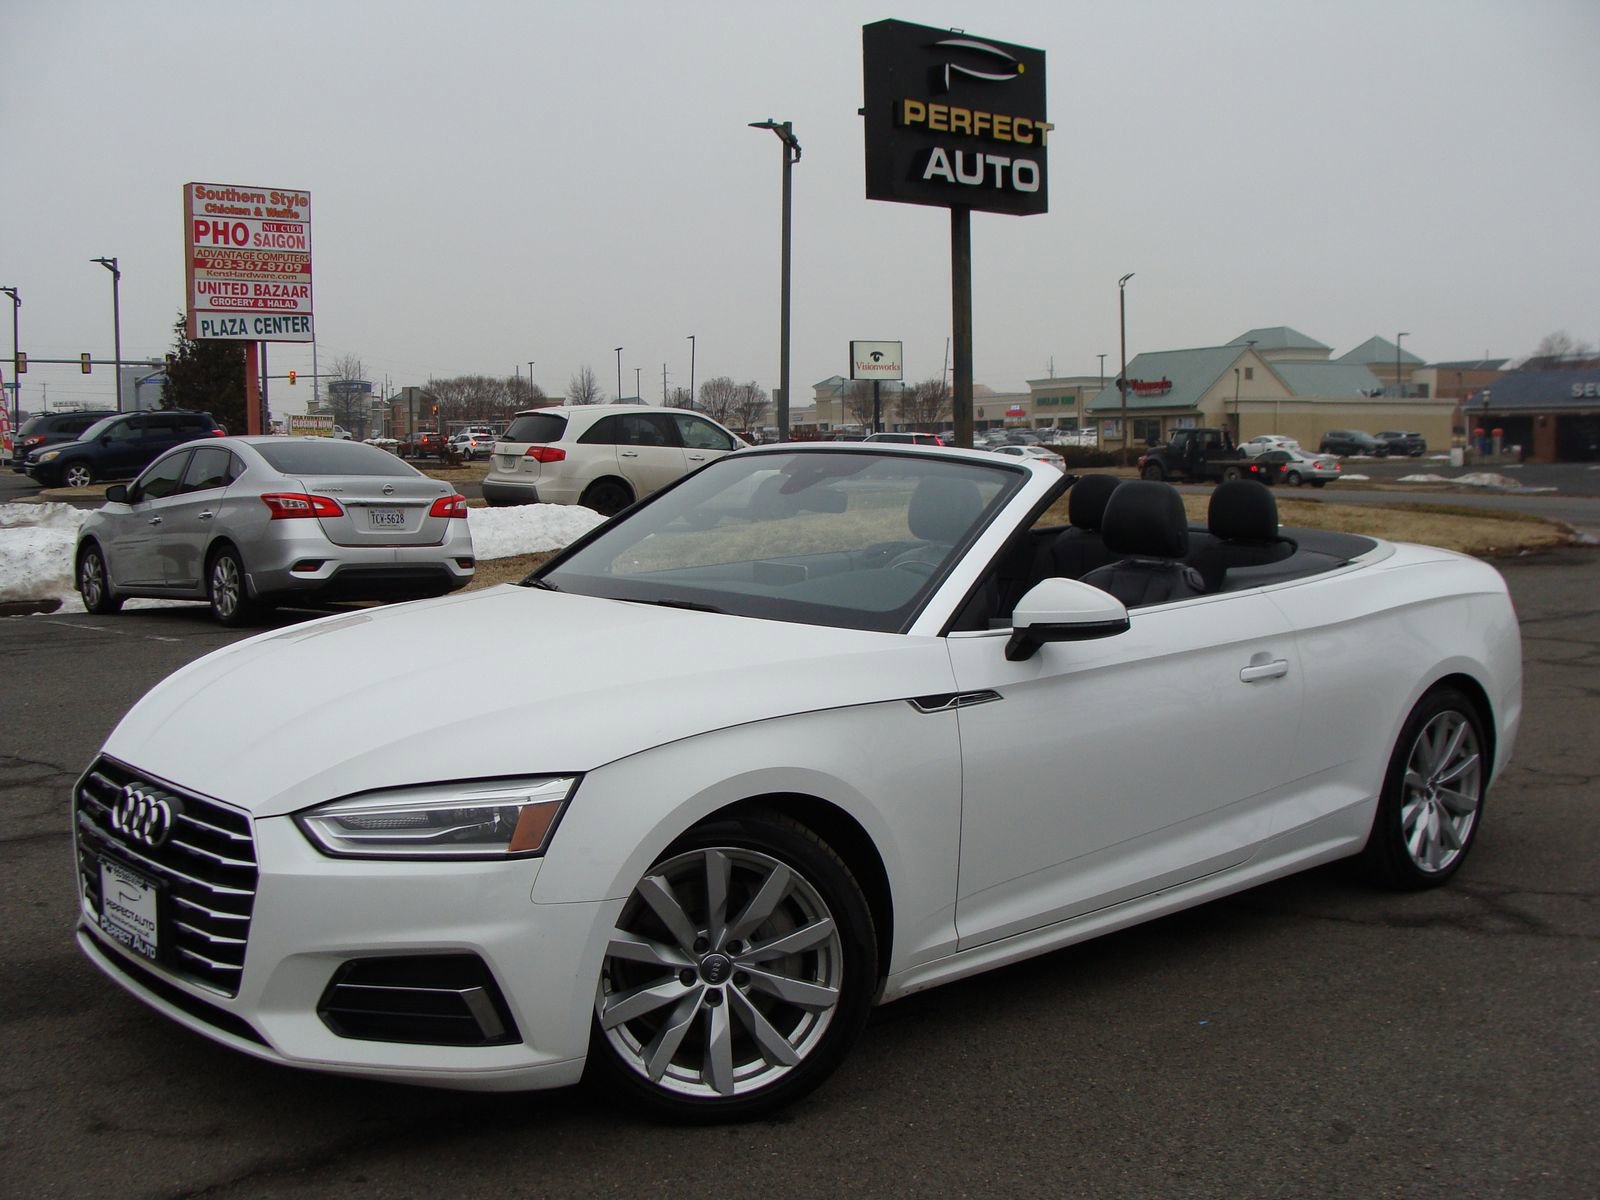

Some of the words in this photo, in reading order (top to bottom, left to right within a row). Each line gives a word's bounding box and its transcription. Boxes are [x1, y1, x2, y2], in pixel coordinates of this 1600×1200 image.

[903, 98, 1054, 147] PERFECT
[922, 147, 1040, 192] AUTO
[195, 186, 266, 204] Southern
[270, 191, 308, 208] Style
[204, 203, 251, 216] Chicken
[253, 207, 263, 217] &
[194, 220, 250, 246] PHO
[253, 232, 306, 249] SAIGON
[196, 249, 255, 260] ADVANTAGE
[256, 253, 309, 263] COMPUTERS
[205, 259, 302, 272] 703-367-8709
[206, 269, 297, 280] KensHardware.com
[197, 281, 249, 296] UNITED
[253, 283, 308, 298] BAZAAR
[211, 297, 255, 307] GROCERY
[257, 299, 265, 307] &
[267, 300, 296, 309] HALAL
[201, 318, 248, 337] PLAZA
[254, 316, 311, 335] CENTER
[855, 361, 901, 371] Visionworks
